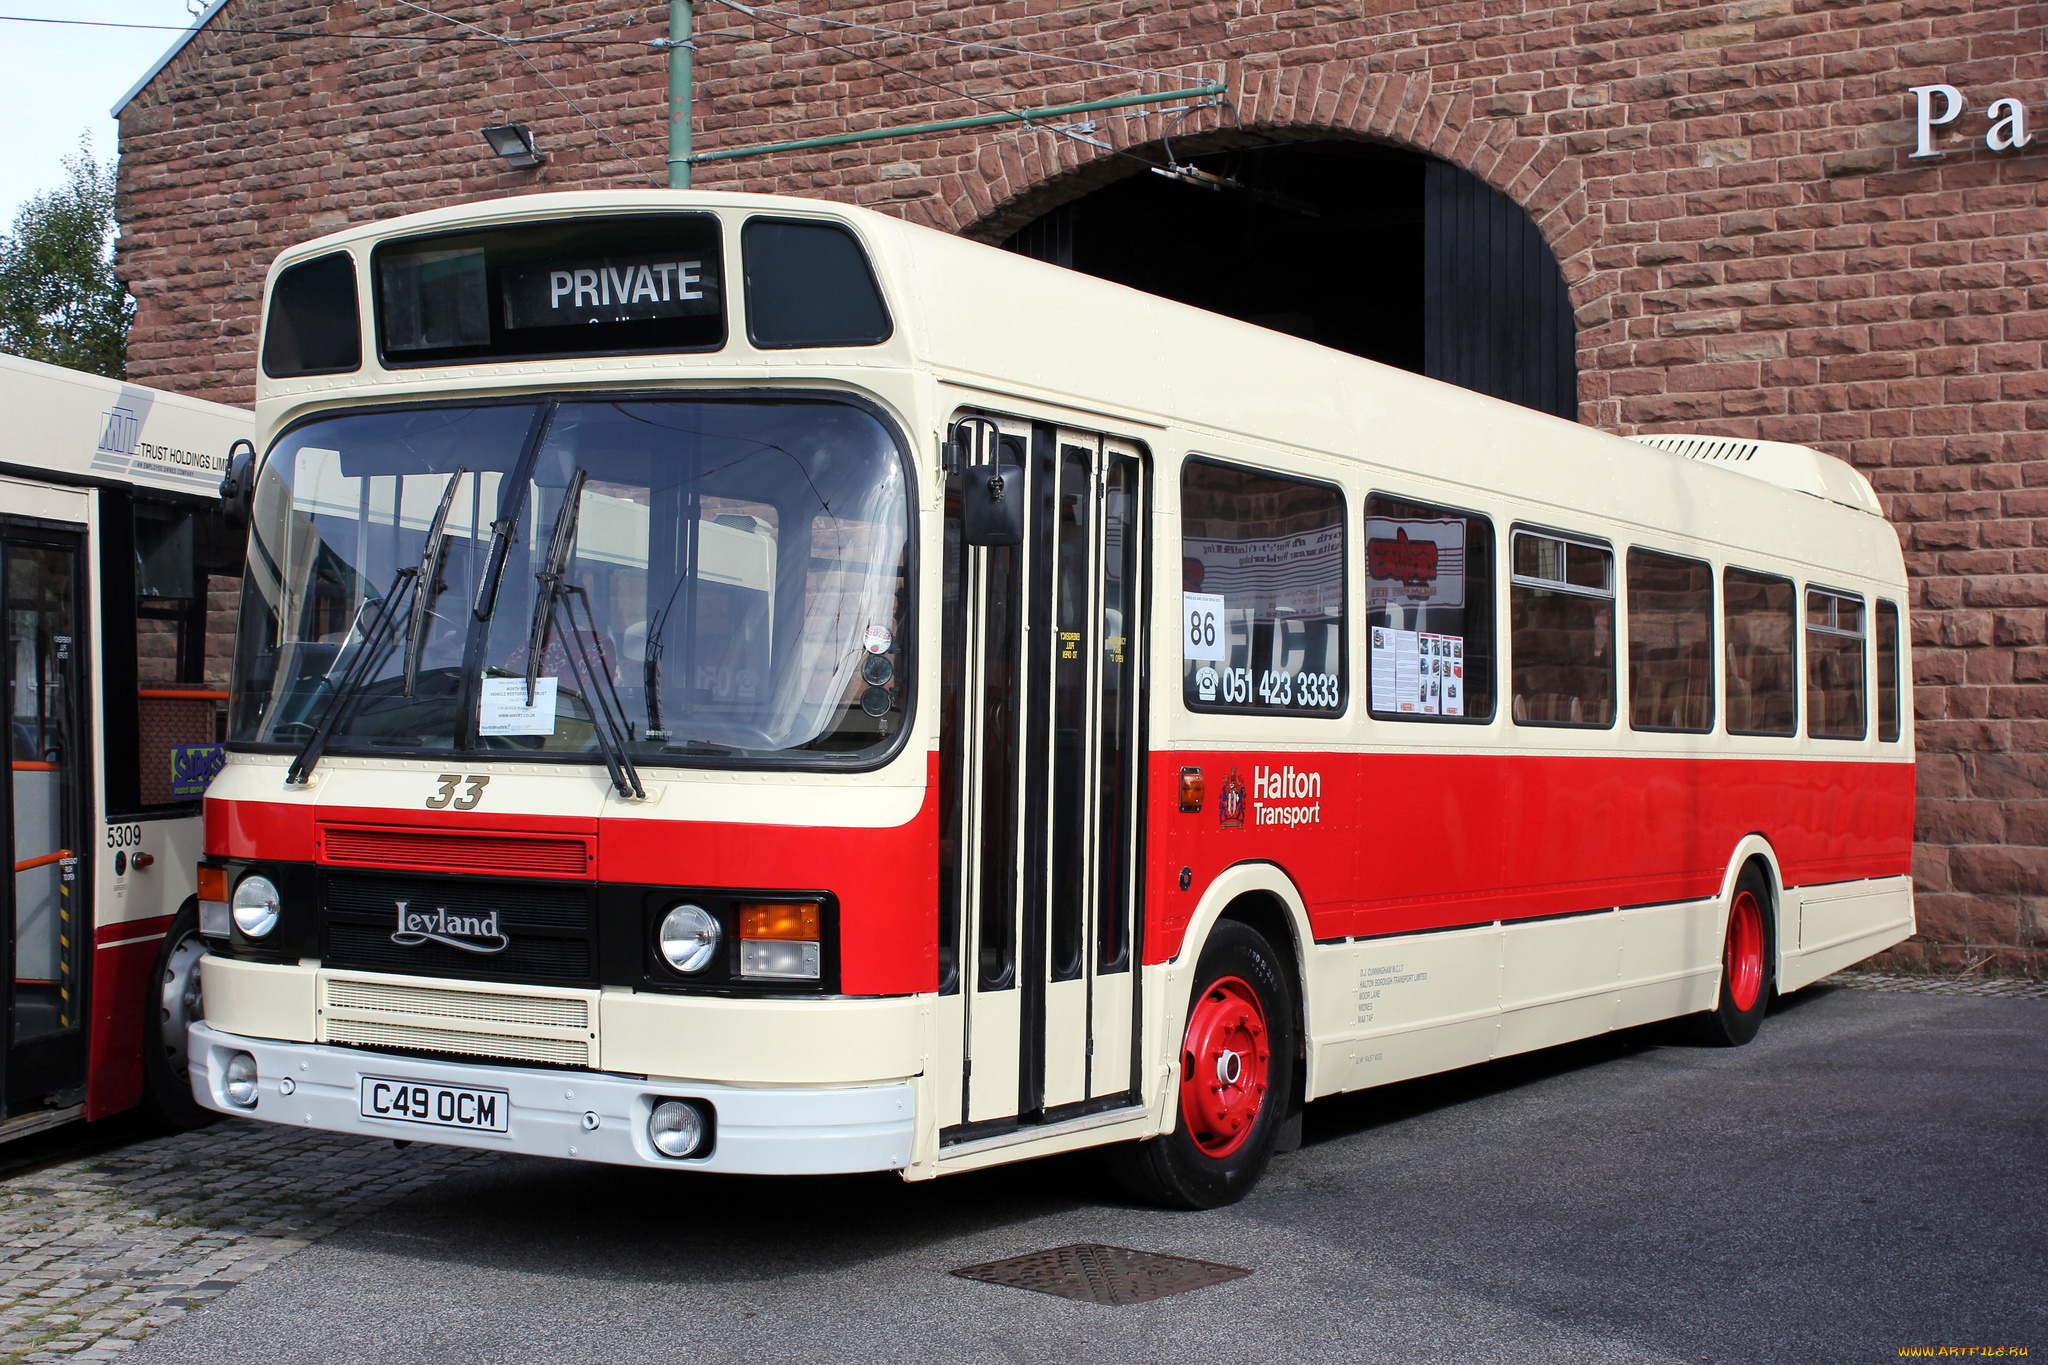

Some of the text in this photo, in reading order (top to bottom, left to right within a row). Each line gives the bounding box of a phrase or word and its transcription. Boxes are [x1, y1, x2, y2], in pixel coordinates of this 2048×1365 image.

[550, 261, 703, 308] PRIVATE
[141, 442, 168, 461] TRUST
[169, 448, 211, 469] HOLDINGS
[1190, 610, 1216, 647] 86
[1222, 666, 1339, 707] 051 423 3333
[426, 774, 491, 810] 33
[1253, 765, 1321, 799] Halton
[1253, 801, 1320, 829] Transport
[107, 824, 142, 848] 5309
[393, 901, 505, 944] Leyland
[1359, 972, 1428, 989] HALTON BOROUGH TRANSPORT LIMITED
[1370, 990, 1381, 999] LANE
[373, 1083, 496, 1127] C49 OCM
